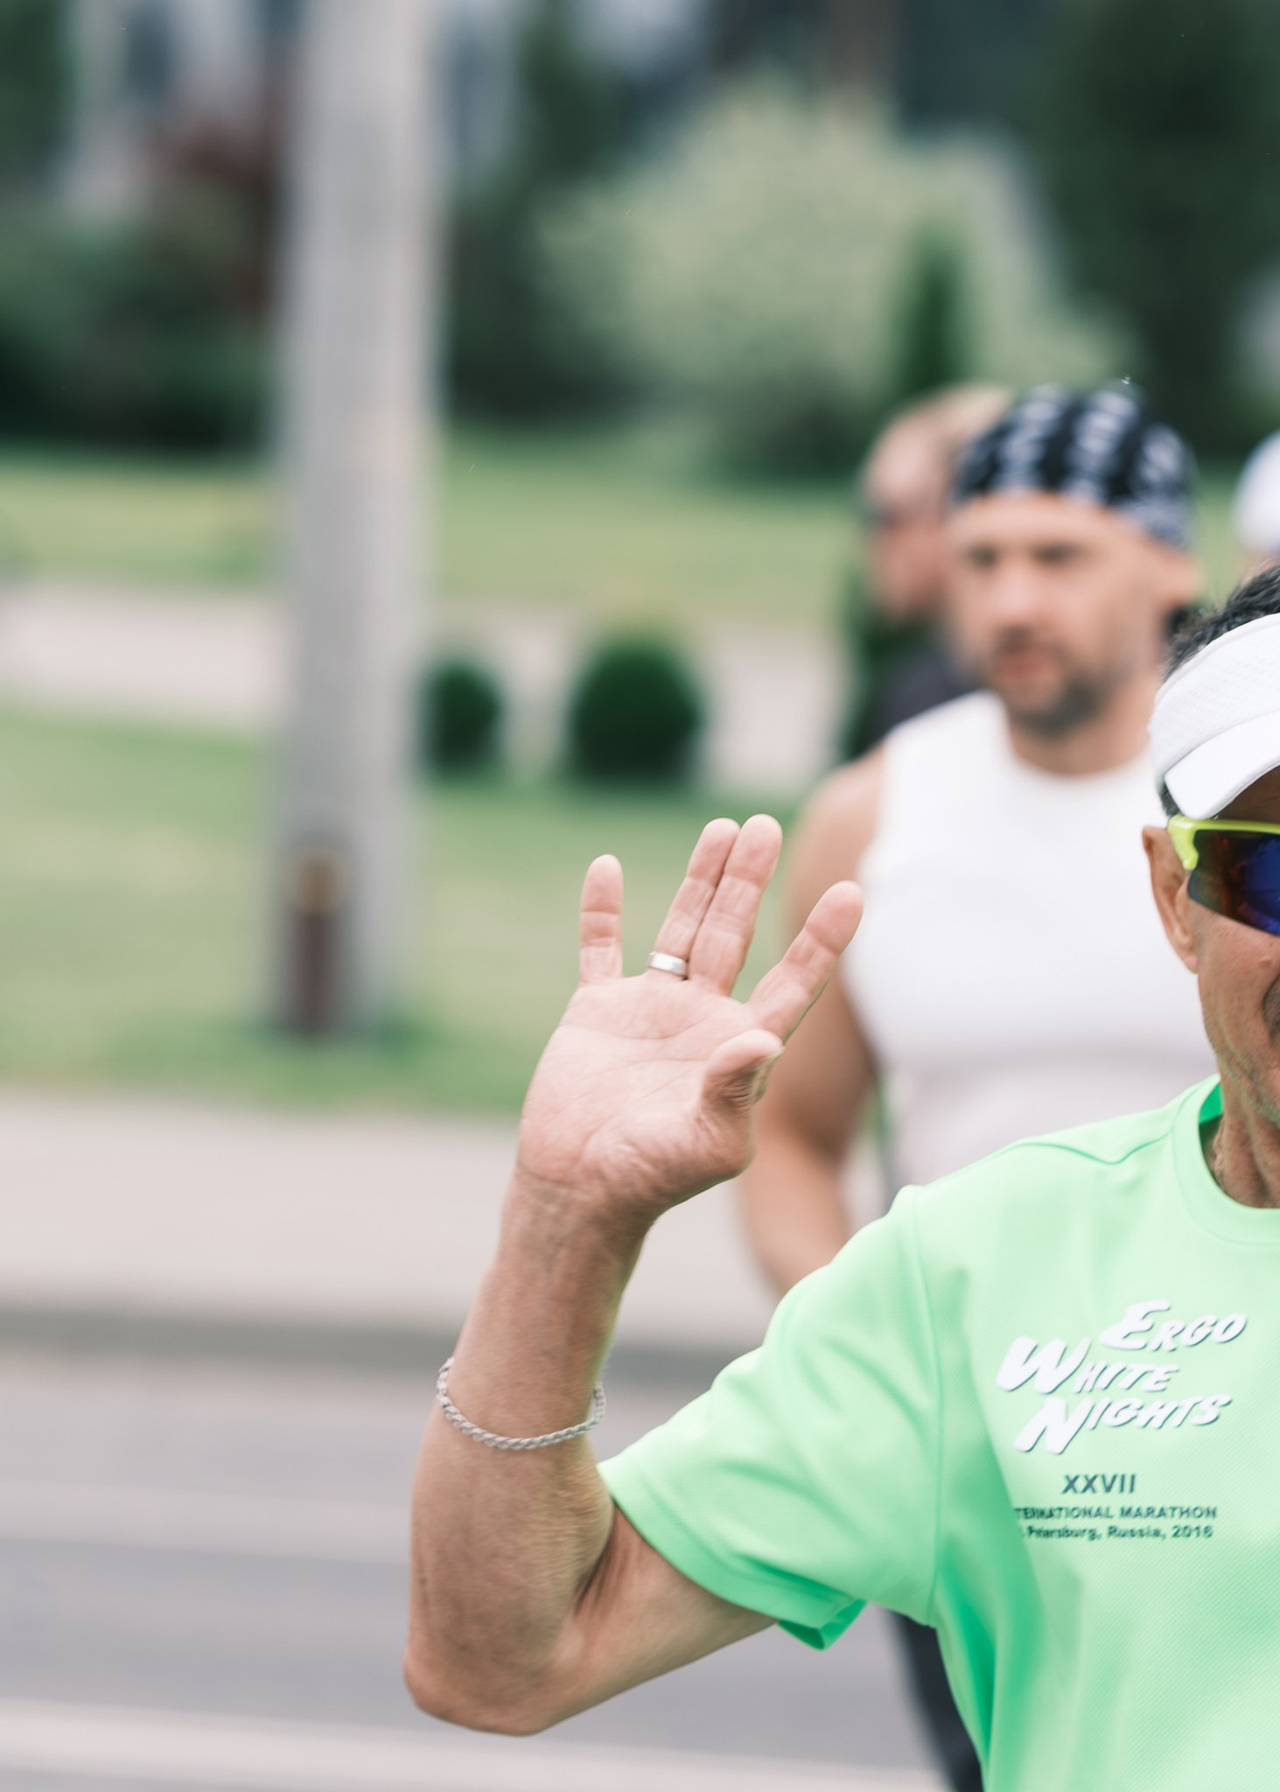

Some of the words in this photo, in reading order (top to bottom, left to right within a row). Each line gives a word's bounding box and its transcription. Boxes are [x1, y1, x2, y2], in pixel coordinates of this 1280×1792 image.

[1099, 1299, 1248, 1352] ERGO
[996, 1336, 1180, 1394] WHITE
[1013, 1395, 1233, 1455] NIGHTS
[1062, 1474, 1137, 1494] XXVII
[1120, 1506, 1217, 1519] MARATHON
[1107, 1525, 1166, 1539] Russia,
